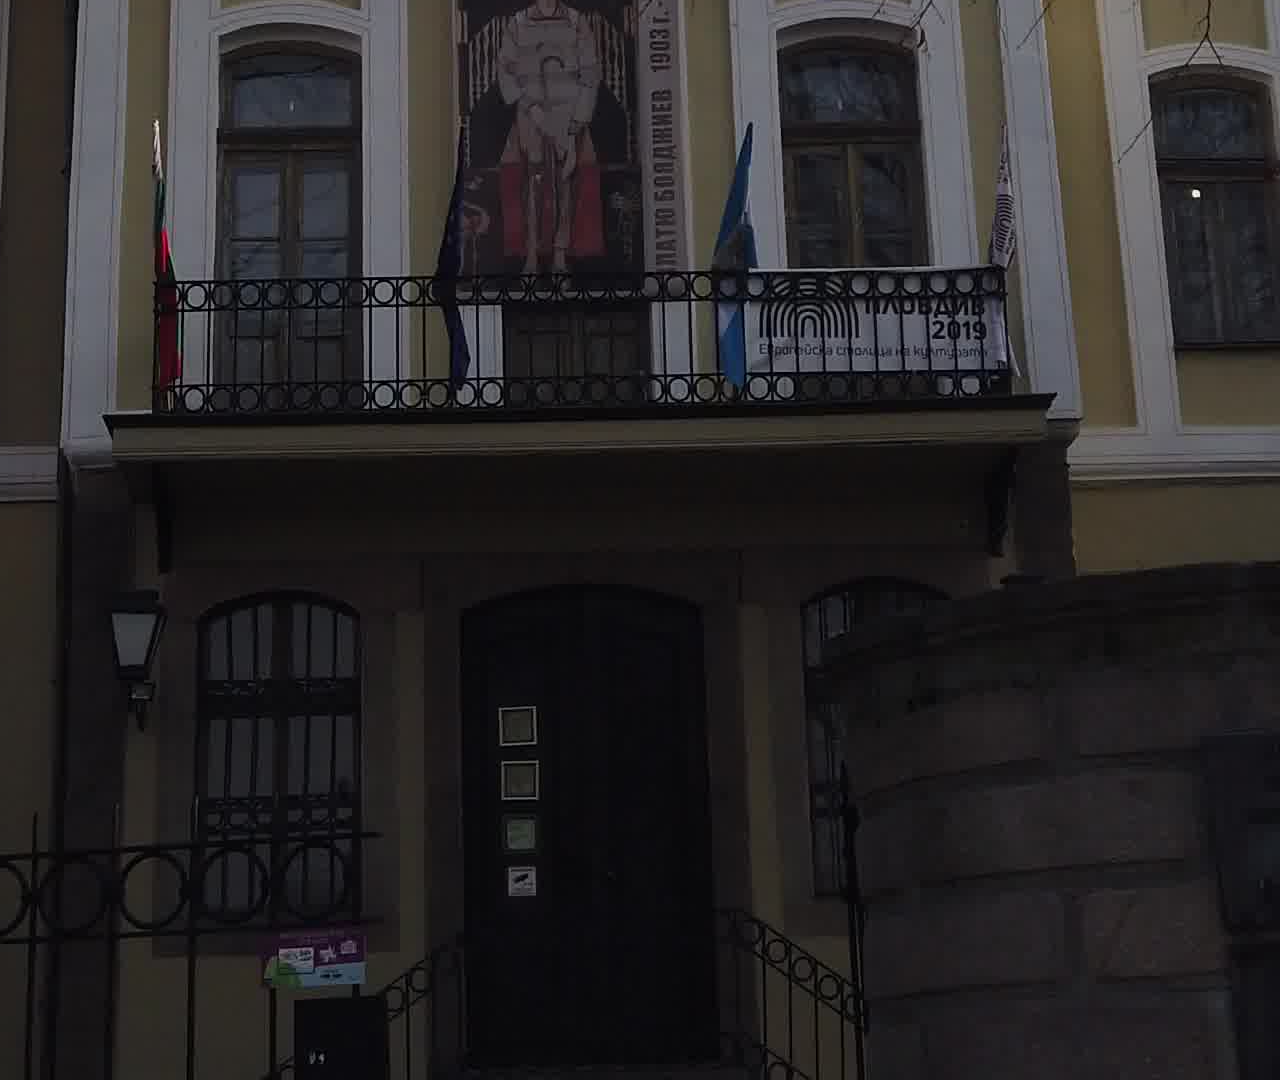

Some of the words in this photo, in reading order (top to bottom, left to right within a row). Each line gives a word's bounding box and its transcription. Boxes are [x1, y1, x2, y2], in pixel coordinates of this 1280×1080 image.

[649, 29, 671, 72] 1903
[651, 88, 677, 201] БОЯДЖИЕВ
[655, 208, 677, 273] ЛАТЮ
[865, 296, 985, 319] ПЛОВДИВ
[931, 321, 987, 340] 2019
